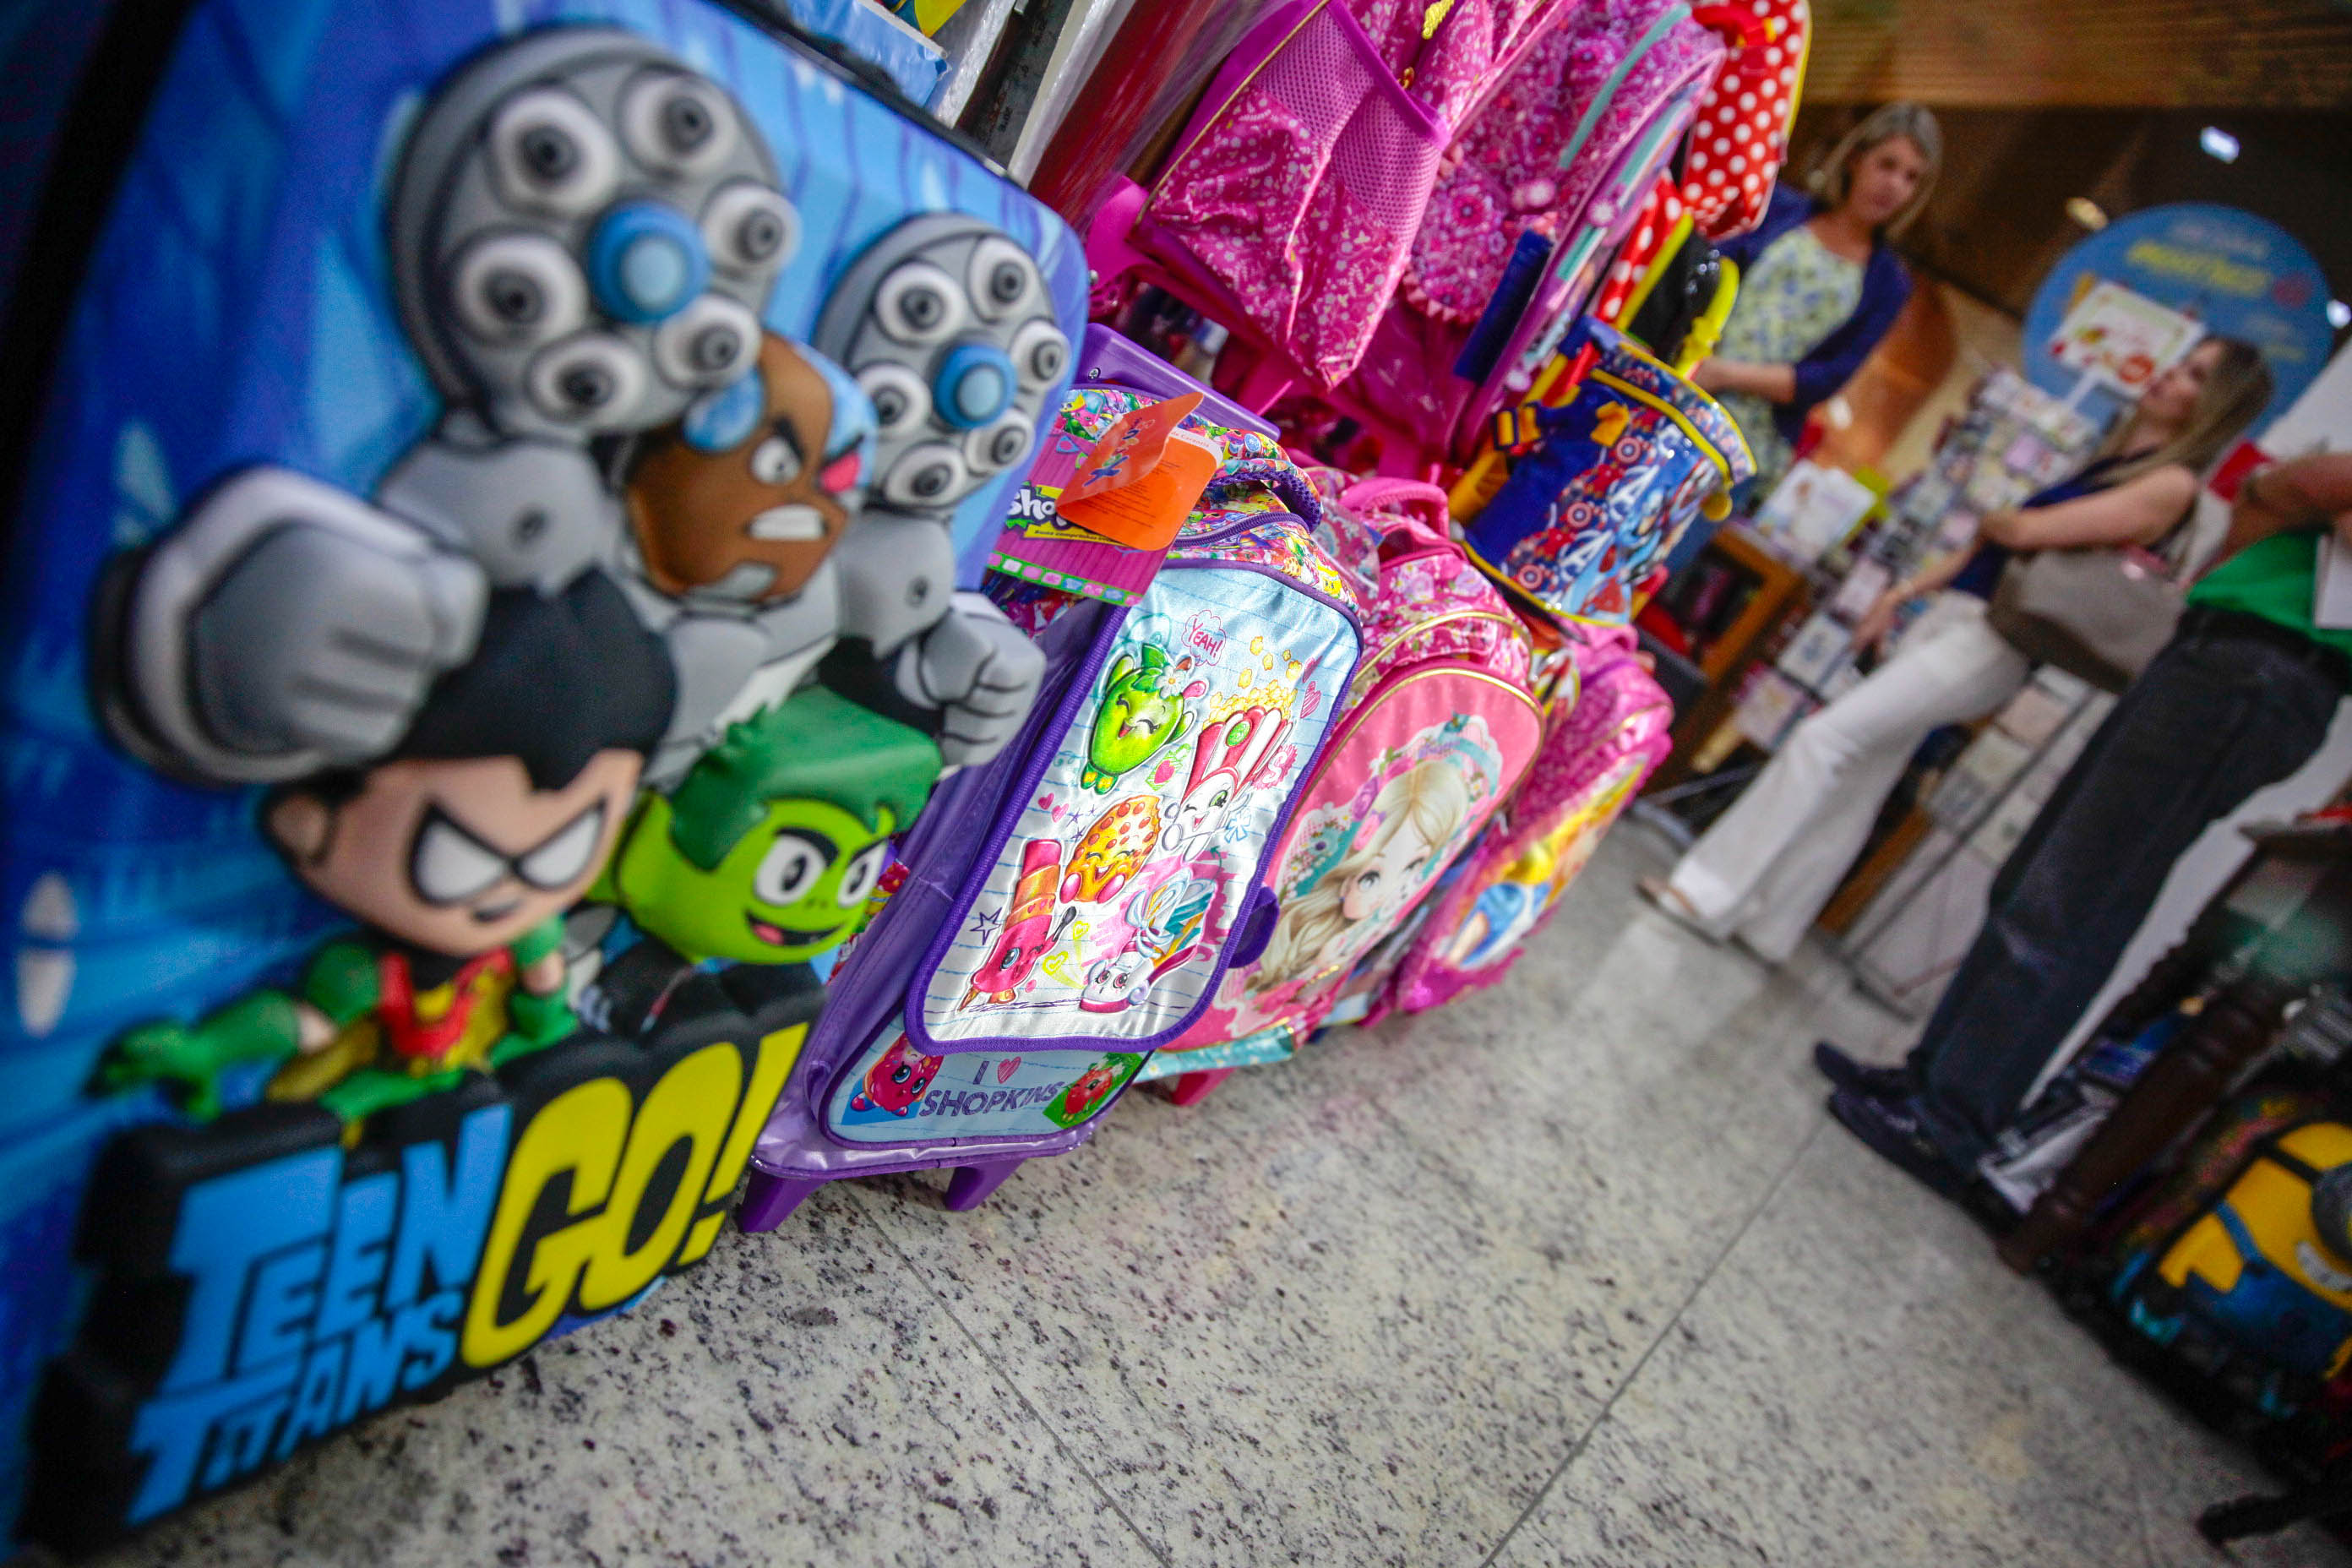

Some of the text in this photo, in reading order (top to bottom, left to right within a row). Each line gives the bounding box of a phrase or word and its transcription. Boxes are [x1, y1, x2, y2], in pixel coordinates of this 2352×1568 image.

[1188, 618, 1223, 658] YEAH!
[918, 1081, 1065, 1117] SHOPKINS
[972, 1060, 990, 1085] I
[158, 1102, 514, 1396] TEEN
[460, 1022, 809, 1369] GO!
[125, 1291, 463, 1522] TITANS
